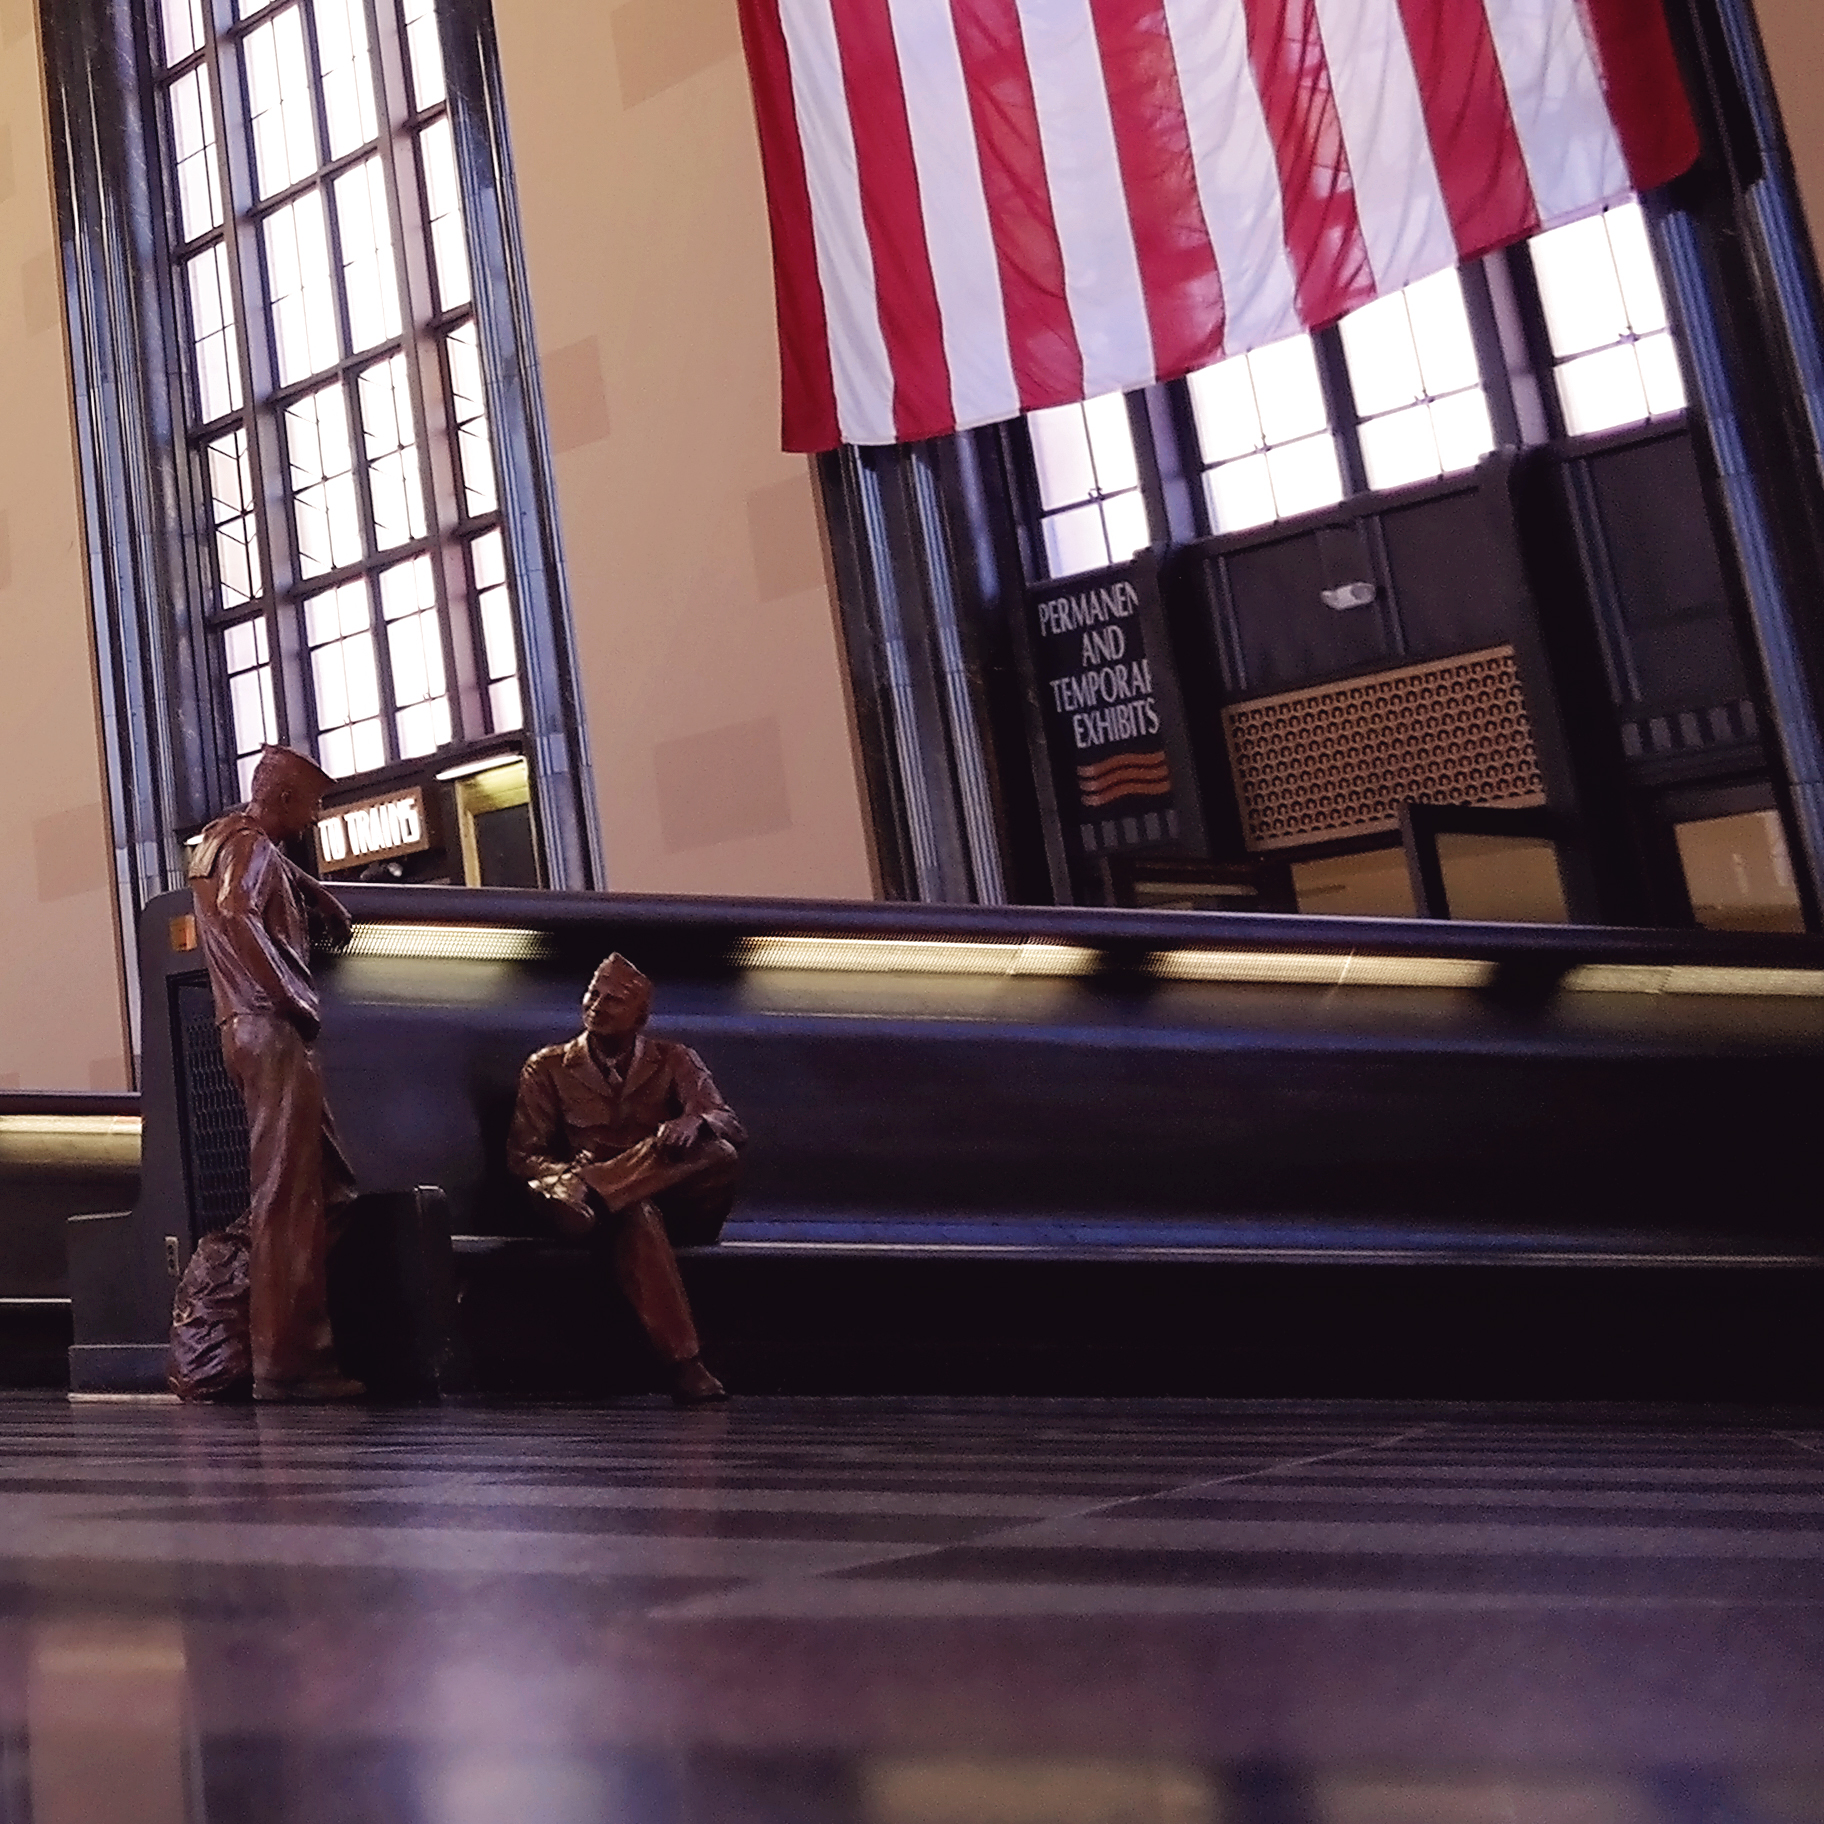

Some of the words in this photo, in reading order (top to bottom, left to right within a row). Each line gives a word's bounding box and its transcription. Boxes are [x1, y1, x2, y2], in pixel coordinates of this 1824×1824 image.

[1082, 625, 1125, 667] AND
[1073, 697, 1160, 749] EXHIBITS
[317, 817, 347, 862] TO
[344, 798, 422, 856] TRAINS
